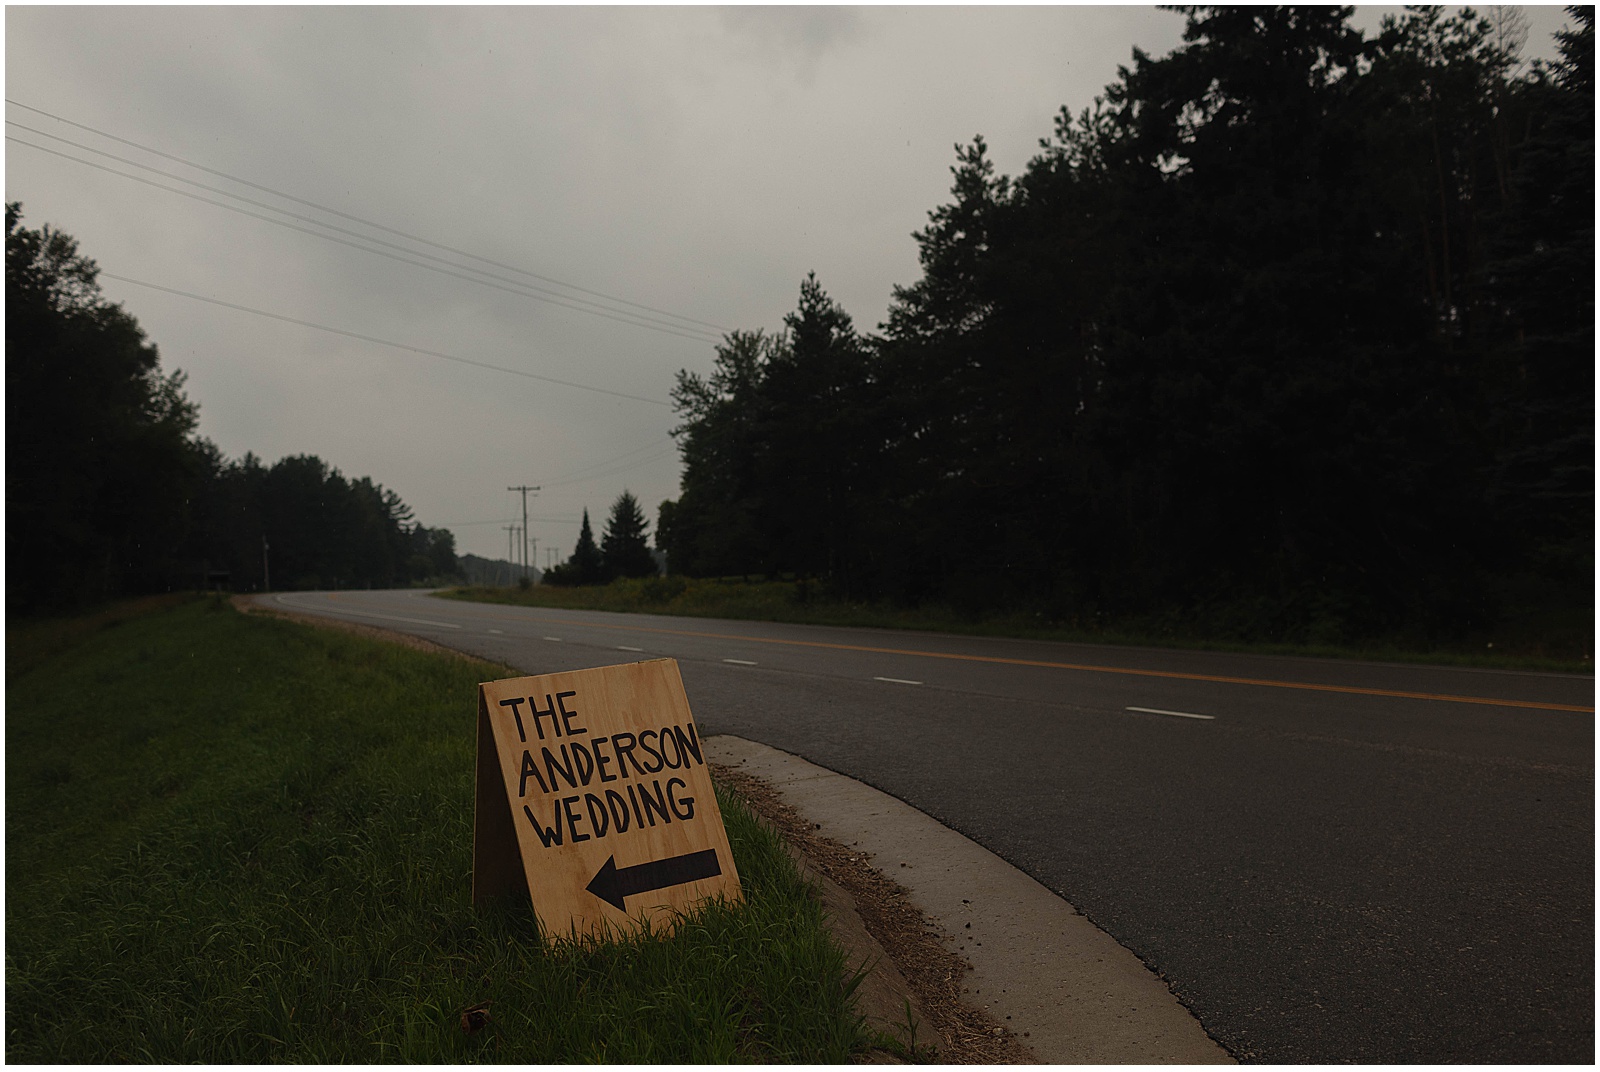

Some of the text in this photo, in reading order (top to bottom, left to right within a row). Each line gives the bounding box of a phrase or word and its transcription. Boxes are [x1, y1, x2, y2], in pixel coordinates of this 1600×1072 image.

[499, 690, 588, 743] THE
[519, 722, 703, 797] ANDERSON
[523, 777, 695, 848] WEDDING
